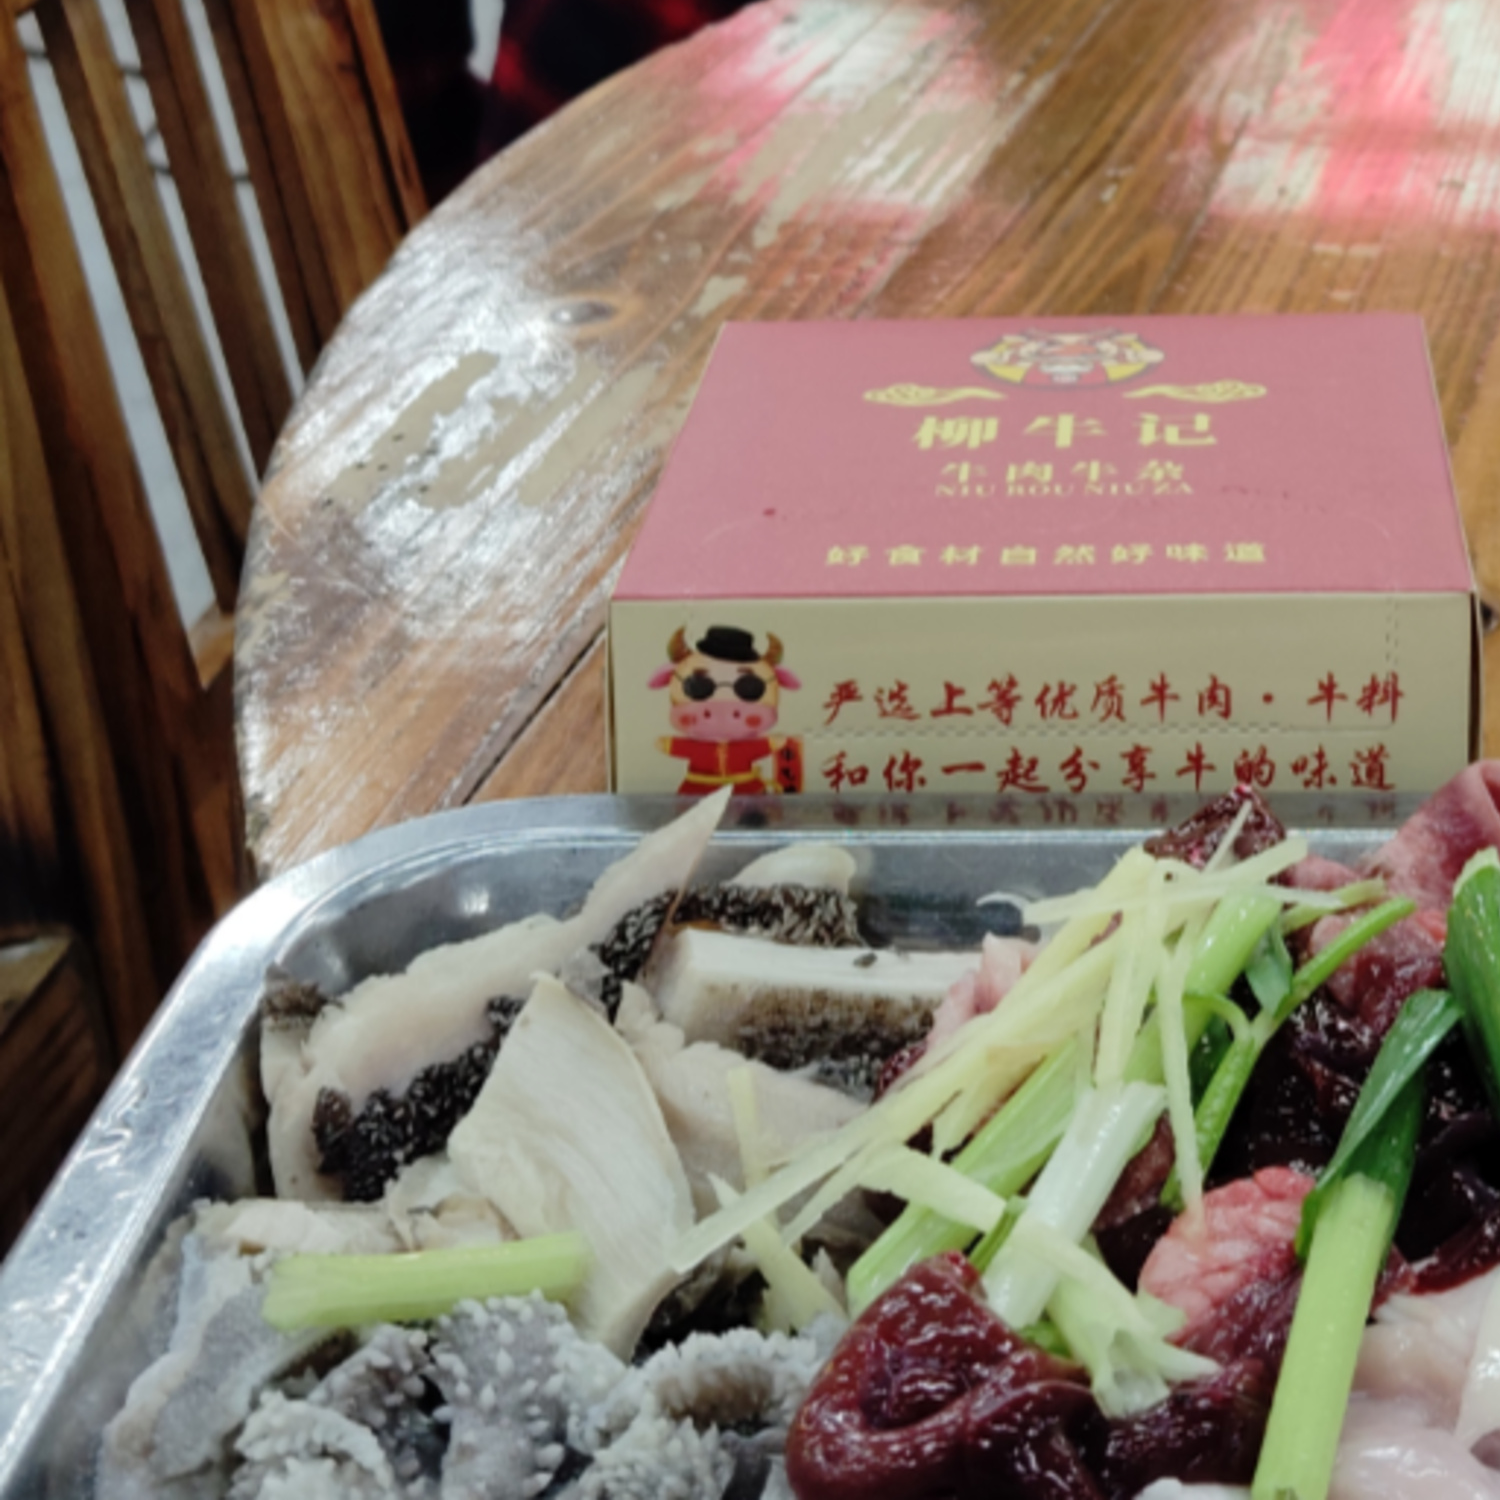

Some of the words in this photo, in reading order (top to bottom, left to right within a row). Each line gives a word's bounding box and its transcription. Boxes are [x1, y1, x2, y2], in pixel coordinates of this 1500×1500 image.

[911, 412, 1218, 449] 柳牛记
[935, 483, 996, 497] NIU
[1006, 483, 1075, 497] ROU
[1085, 483, 1145, 497] NIU
[1152, 482, 1195, 496] ZA
[824, 542, 1269, 567] 好食材自然好味道
[821, 741, 1396, 795] 和你一起分享牛的味道
